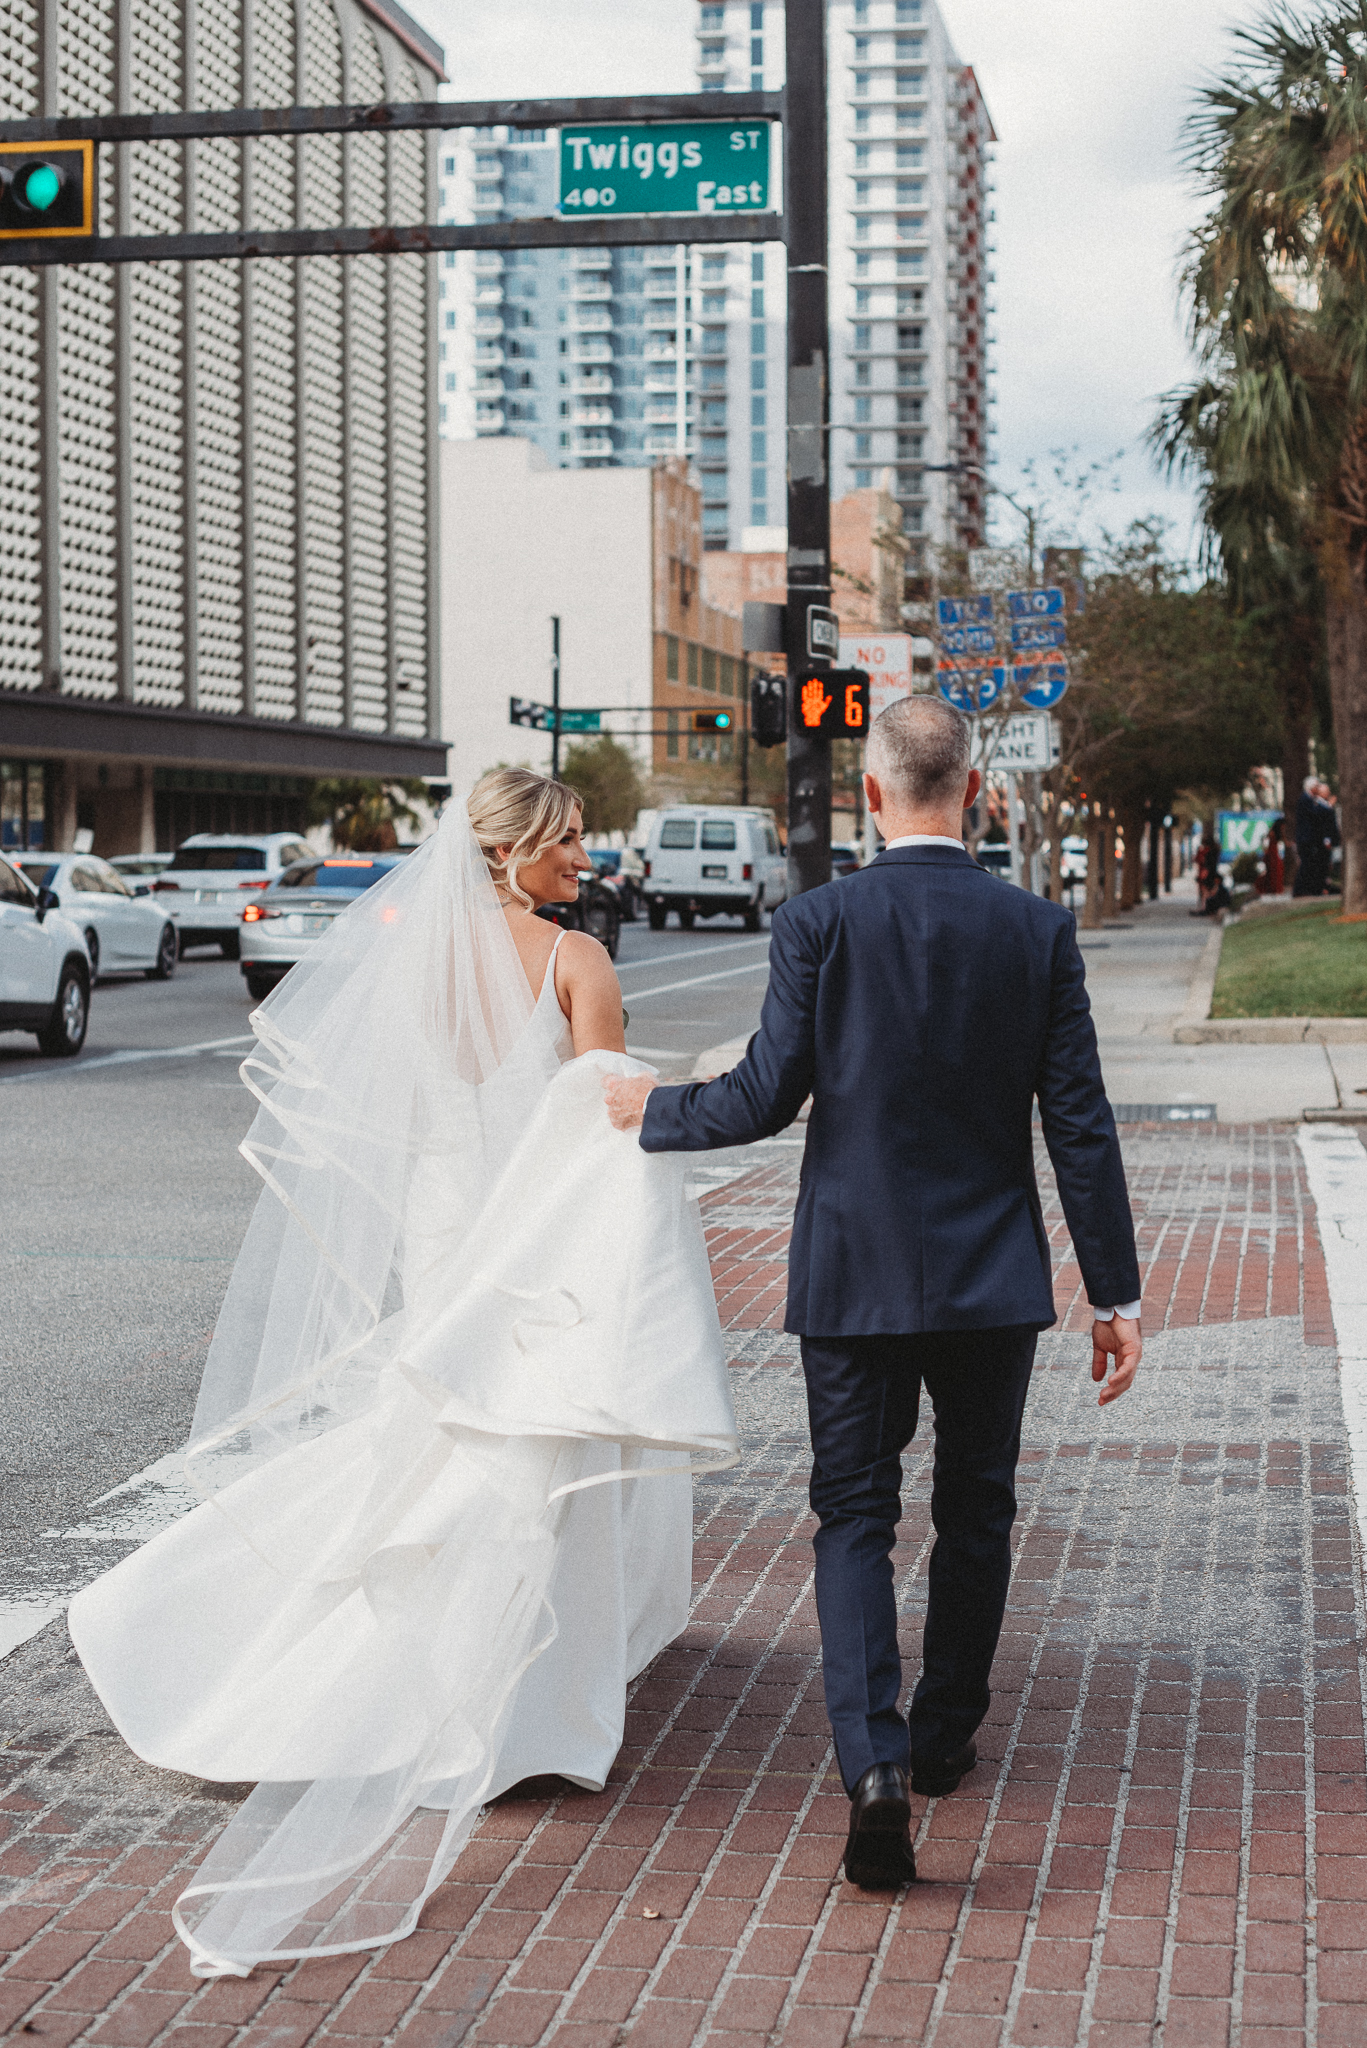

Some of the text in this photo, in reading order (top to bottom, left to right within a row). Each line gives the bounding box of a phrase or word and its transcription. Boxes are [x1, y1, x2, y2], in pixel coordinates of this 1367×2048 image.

[565, 131, 761, 179] Twiggs ST
[564, 180, 763, 207] 400 East
[856, 646, 886, 665] NO
[844, 684, 863, 727] 6
[986, 742, 1036, 760] ANE
